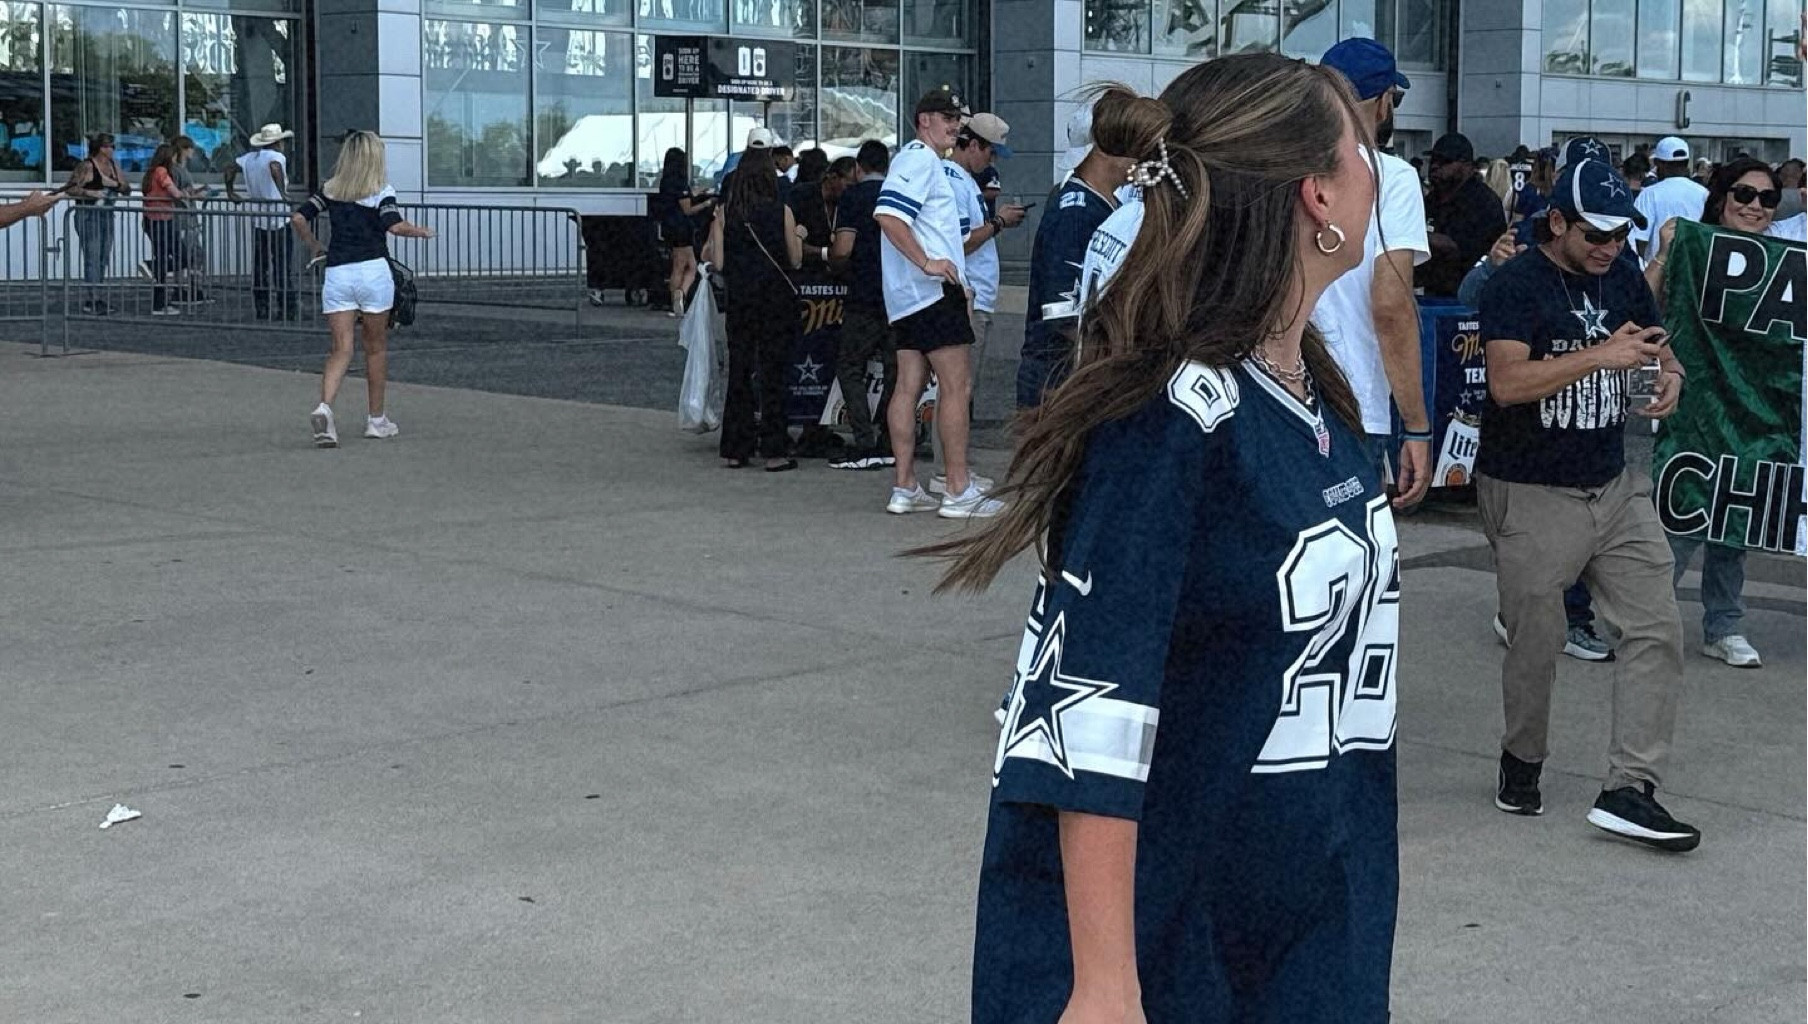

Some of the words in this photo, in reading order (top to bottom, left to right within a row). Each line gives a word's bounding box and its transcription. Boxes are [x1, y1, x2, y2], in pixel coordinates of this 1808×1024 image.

[678, 54, 700, 65] HERE
[717, 84, 760, 95] DESIGNATED
[761, 86, 785, 96] DRIVER
[1514, 171, 1526, 192] 8
[1059, 191, 1087, 211] 21
[800, 285, 834, 296] TASTES
[1464, 367, 1487, 384] TEX
[1447, 430, 1478, 460] Lite
[1250, 491, 1400, 773] 26
